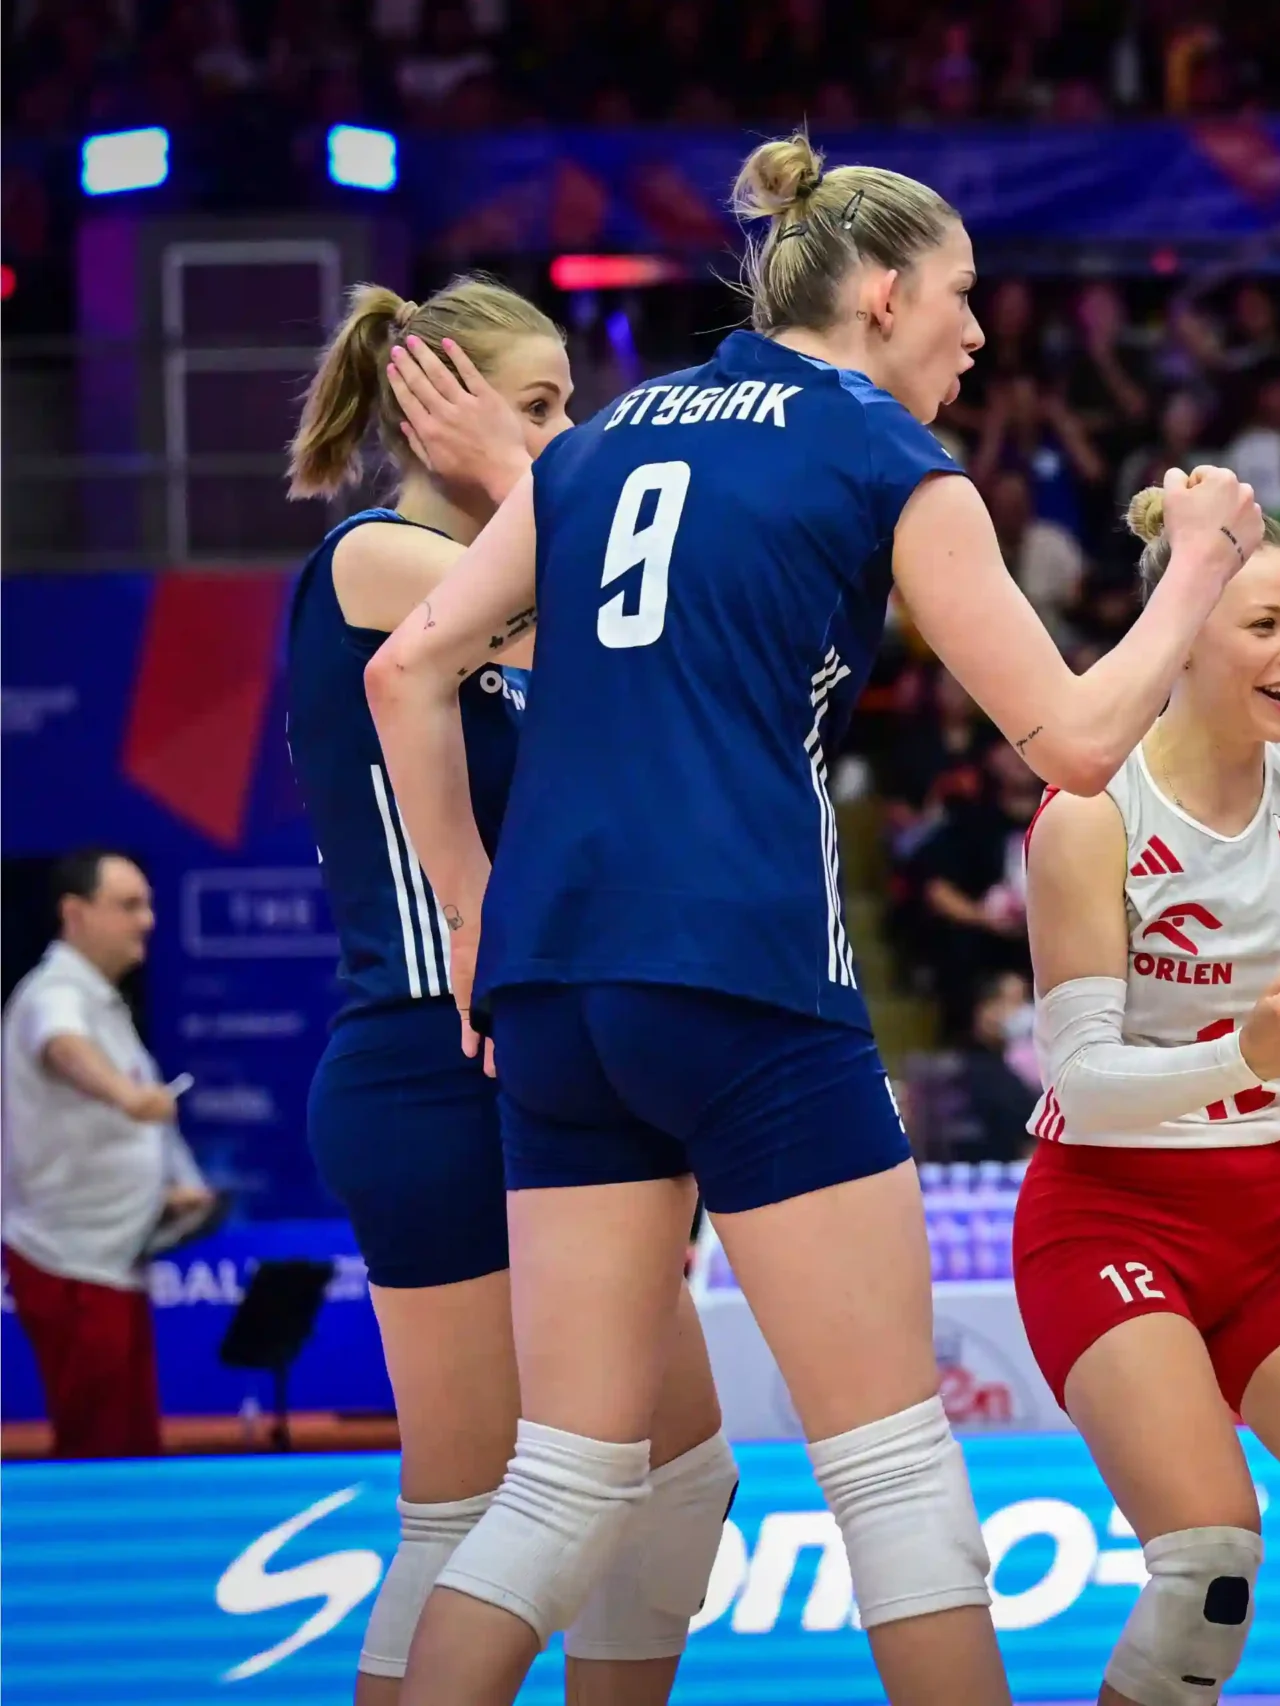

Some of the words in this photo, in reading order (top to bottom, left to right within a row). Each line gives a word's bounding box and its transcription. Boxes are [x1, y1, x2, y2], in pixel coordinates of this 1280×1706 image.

[604, 380, 804, 431] STYSIAK
[597, 460, 691, 649] 9
[1133, 952, 1233, 985] ORLEN
[1099, 1261, 1167, 1304] 12
